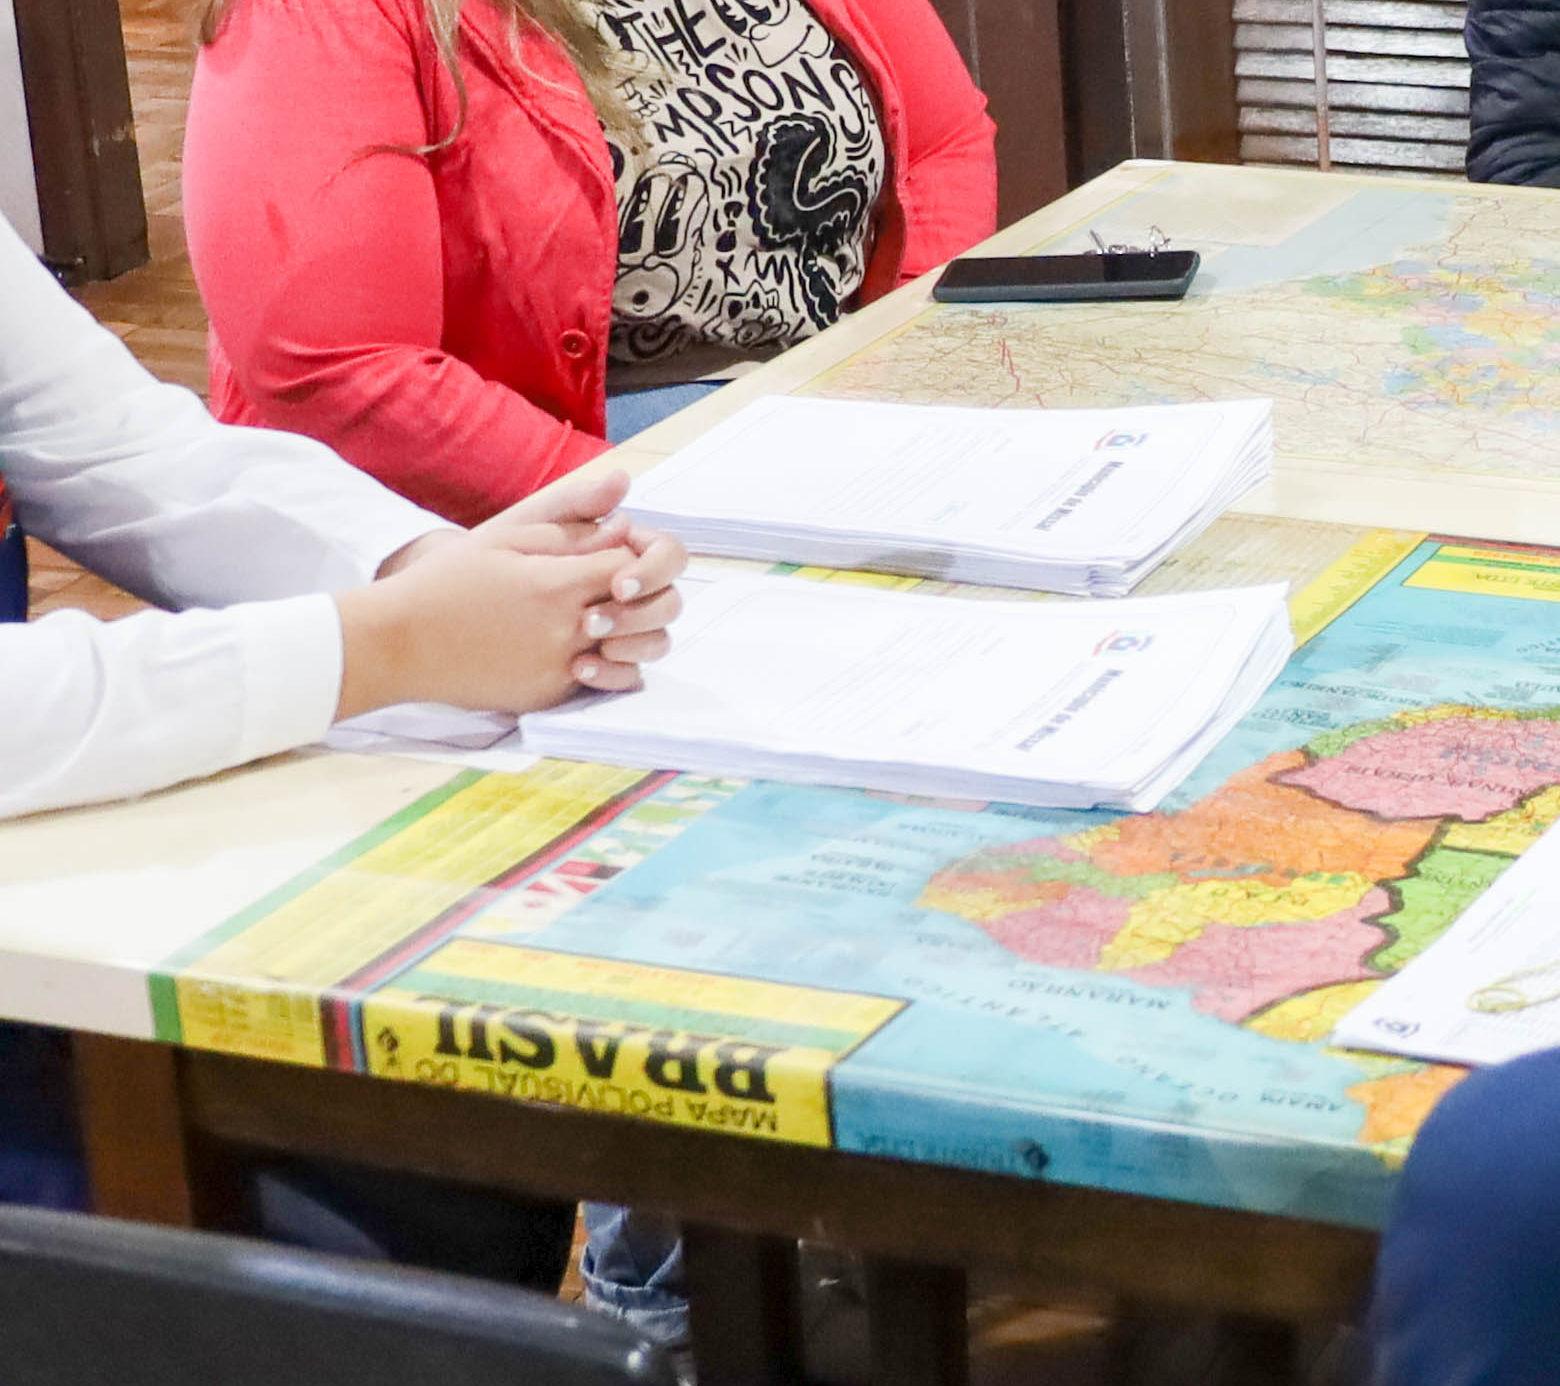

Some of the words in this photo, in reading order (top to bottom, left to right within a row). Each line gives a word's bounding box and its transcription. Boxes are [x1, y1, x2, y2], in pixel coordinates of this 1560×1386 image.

[1007, 977, 1173, 1014] MARANHÃO
[414, 996, 788, 1104] BRASIL
[415, 1057, 462, 1087] DO
[473, 1064, 676, 1119] POLIVISUAL
[681, 1095, 780, 1134] MAPA
